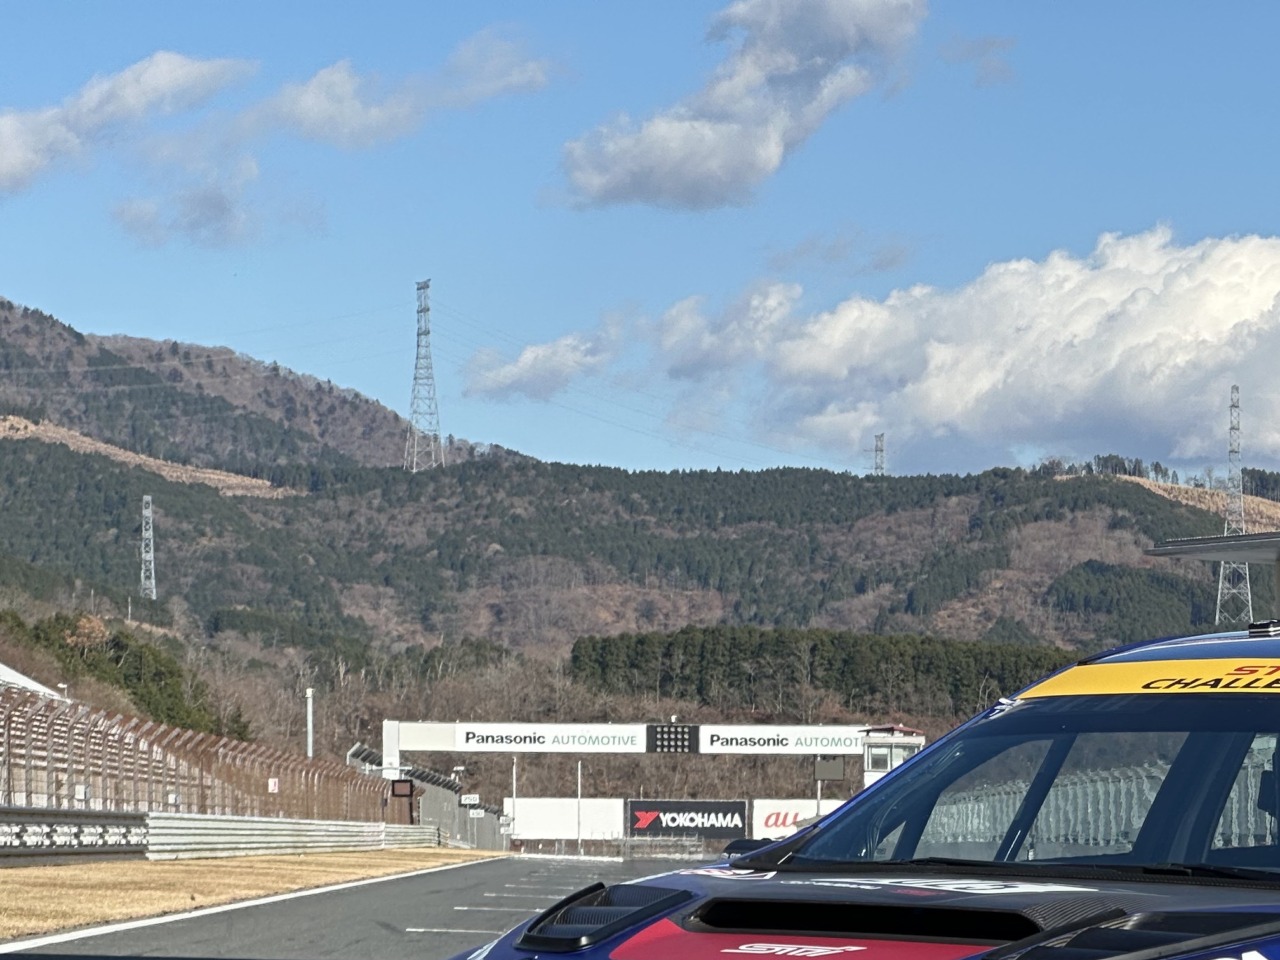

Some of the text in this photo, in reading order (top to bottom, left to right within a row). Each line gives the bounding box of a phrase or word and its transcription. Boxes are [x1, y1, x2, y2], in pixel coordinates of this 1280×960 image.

[465, 732, 637, 746] Panasonic AUTOMOTIVE
[710, 734, 864, 748] Panasonic AUTOMOT
[657, 811, 743, 829] YOKOHAMA
